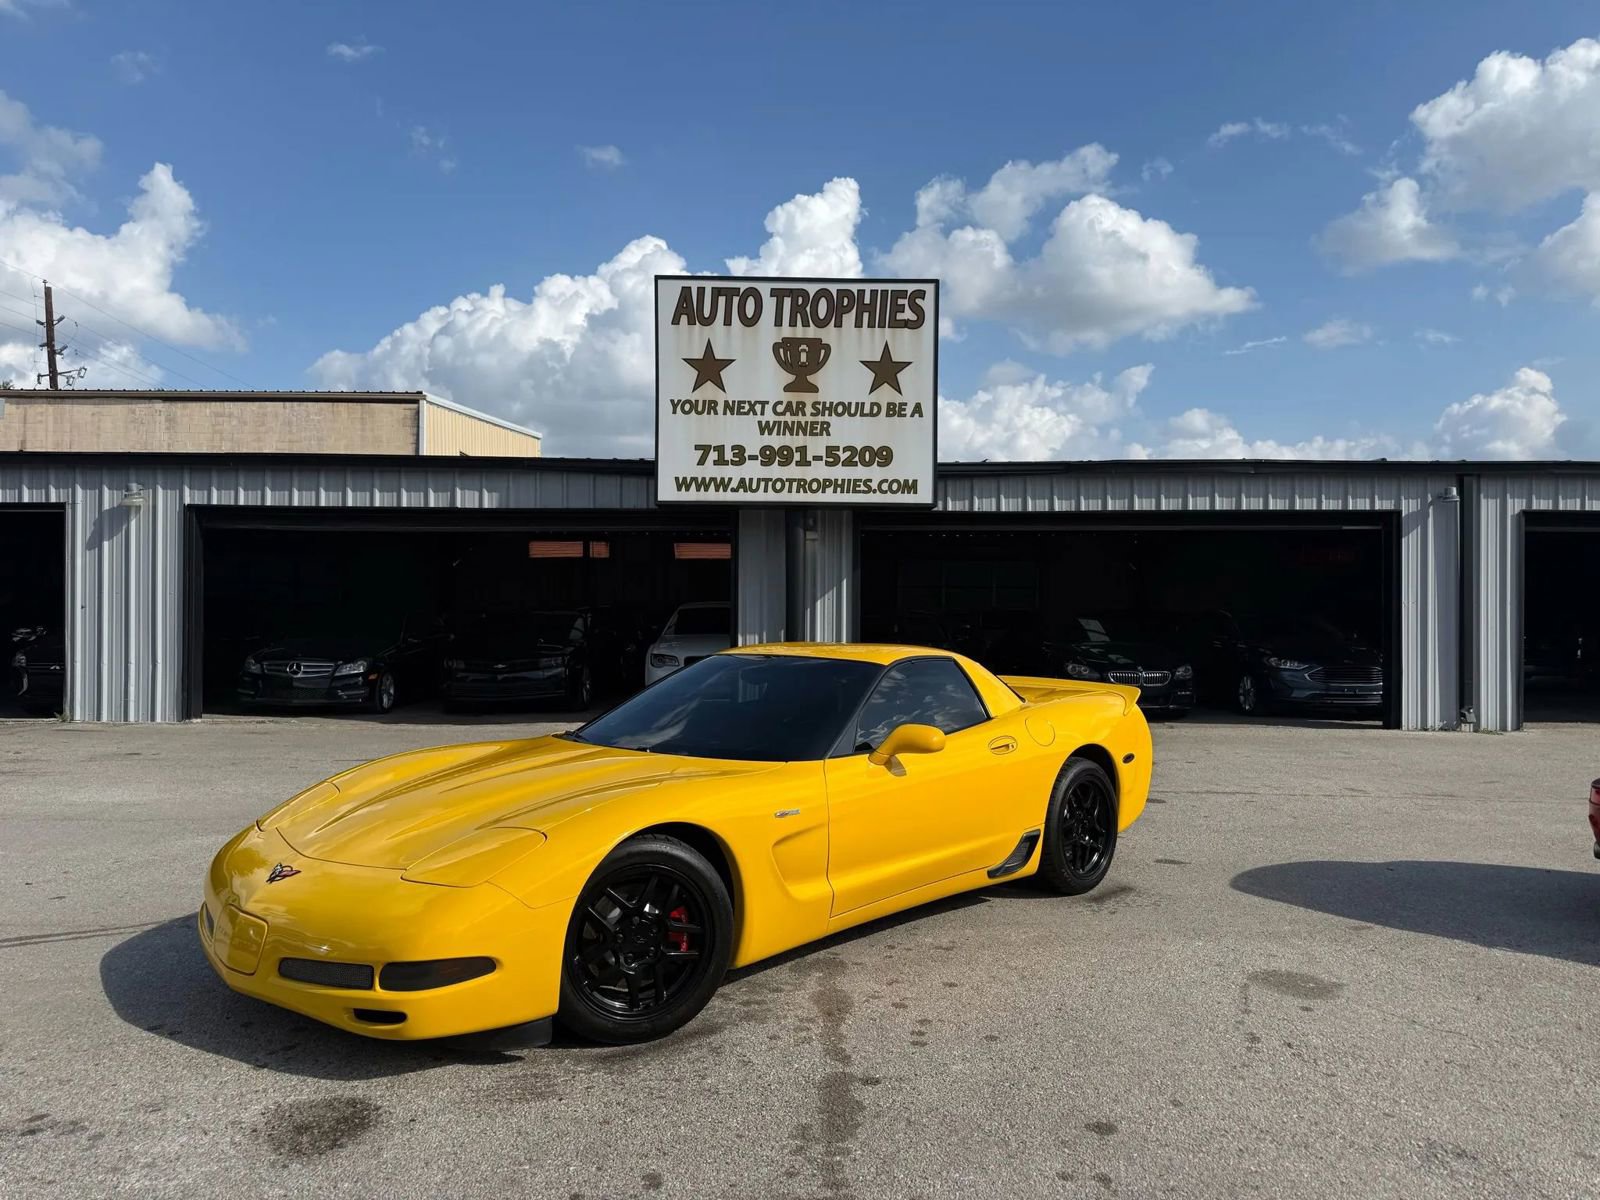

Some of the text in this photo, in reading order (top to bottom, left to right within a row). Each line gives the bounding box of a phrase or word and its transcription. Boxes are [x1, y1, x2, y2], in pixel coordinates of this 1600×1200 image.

[671, 286, 926, 329] AUTO TROPHIES
[670, 399, 924, 417] YOUR NEXT CAR SHOULD BE A
[757, 420, 831, 436] WINNER
[694, 444, 894, 467] 713-991-5209
[674, 476, 918, 494] WWW.AUTOTROPHIES.COM
